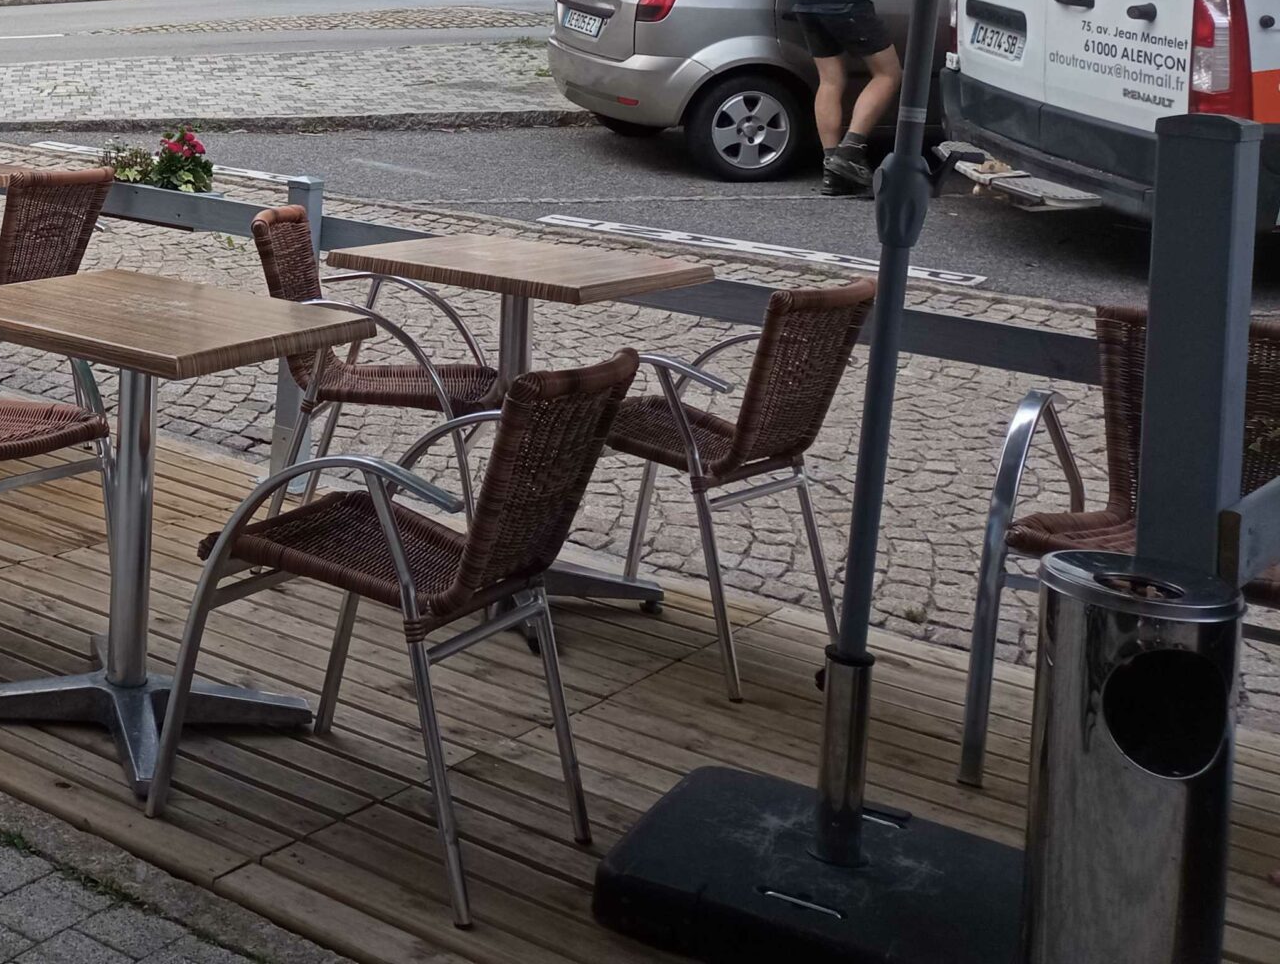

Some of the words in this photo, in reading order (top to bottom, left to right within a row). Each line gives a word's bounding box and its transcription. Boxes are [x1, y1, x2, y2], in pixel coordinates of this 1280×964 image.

[1081, 20, 1094, 34] 75,
[1096, 25, 1111, 36] av.
[1113, 27, 1138, 41] Jean
[1140, 32, 1189, 50] Mantelet
[1049, 50, 1185, 92] atoutravaux@hotmail.fr
[1084, 39, 1118, 58] 61000
[1121, 47, 1187, 73] ALENÇON
[1122, 88, 1175, 108] RENAULT
